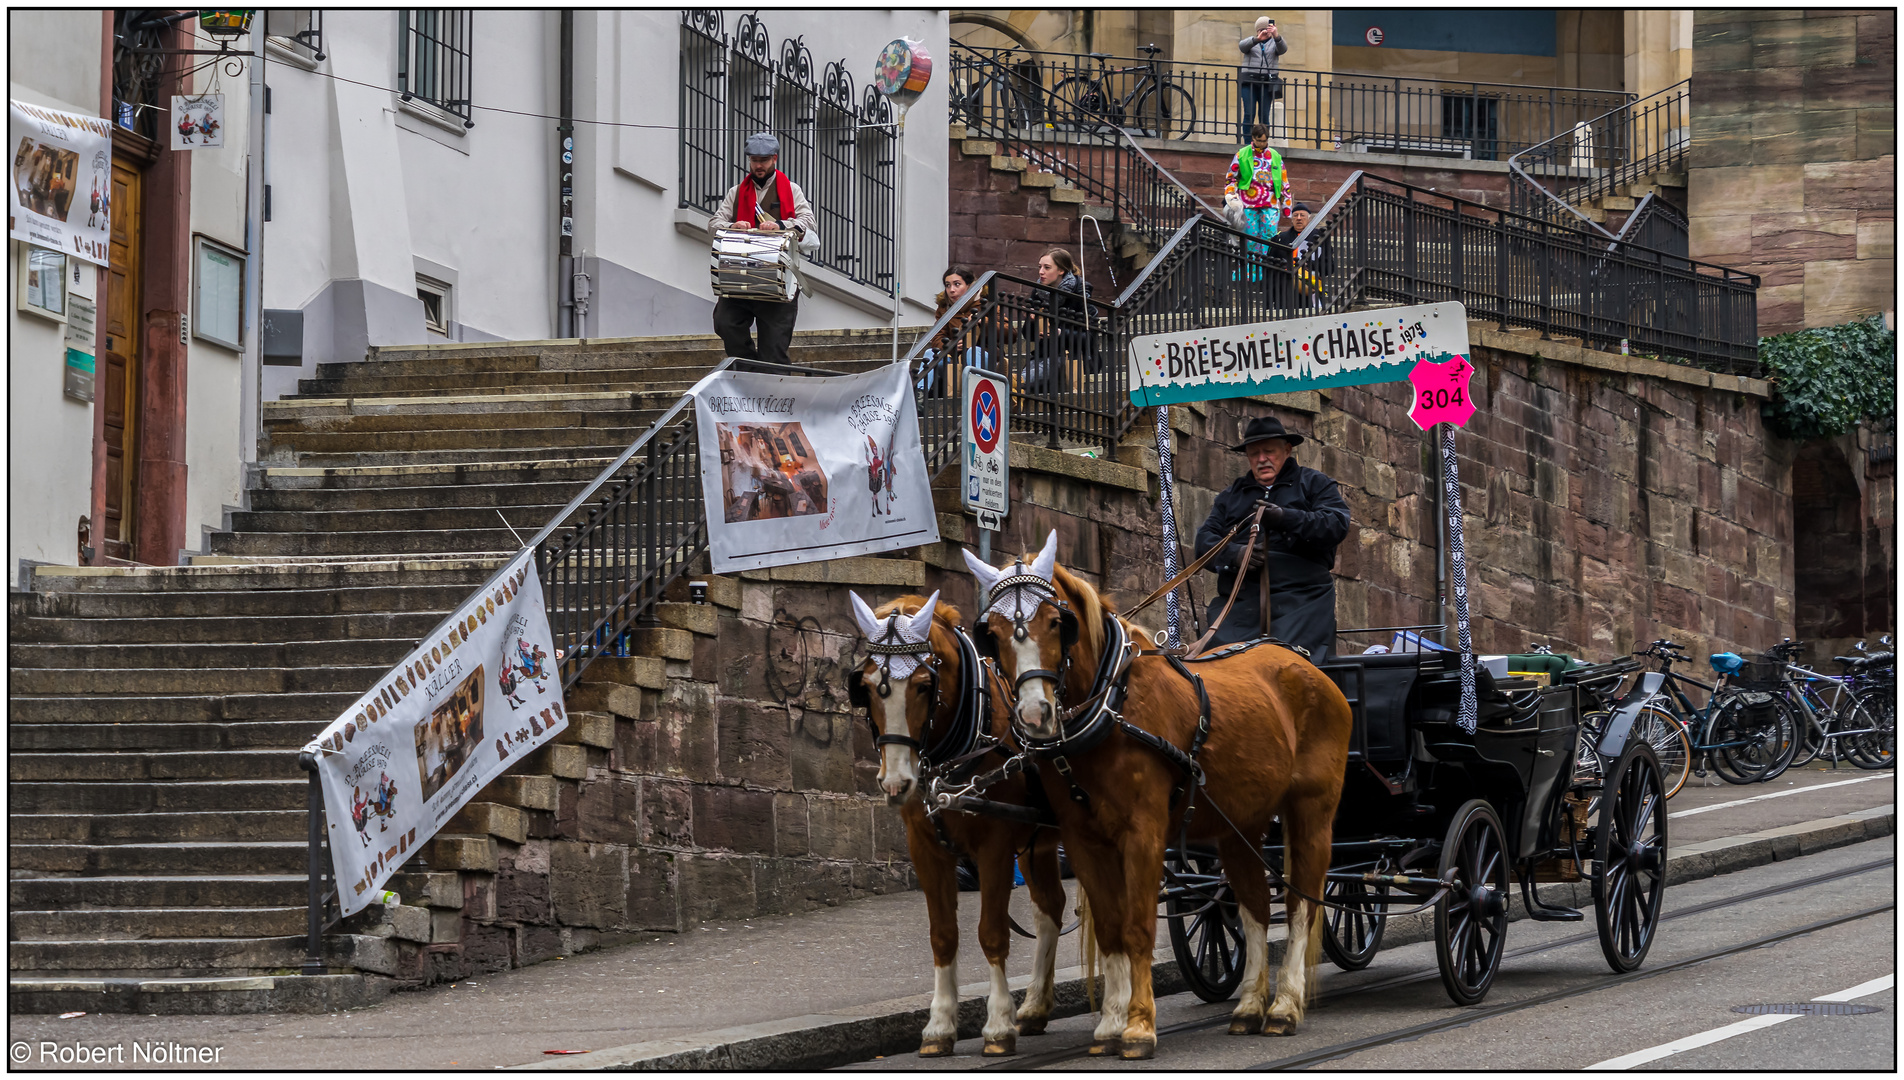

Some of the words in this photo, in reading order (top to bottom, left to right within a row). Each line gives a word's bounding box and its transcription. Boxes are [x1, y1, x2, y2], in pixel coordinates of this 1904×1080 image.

[1166, 333, 1293, 379] BREESMELI
[1312, 327, 1396, 366] CHAISE
[1400, 321, 1425, 344] 1979
[756, 394, 796, 416] KÄLLER
[1420, 386, 1464, 411] 304
[857, 410, 882, 435] CHAISE
[424, 658, 463, 702] KÄLLER
